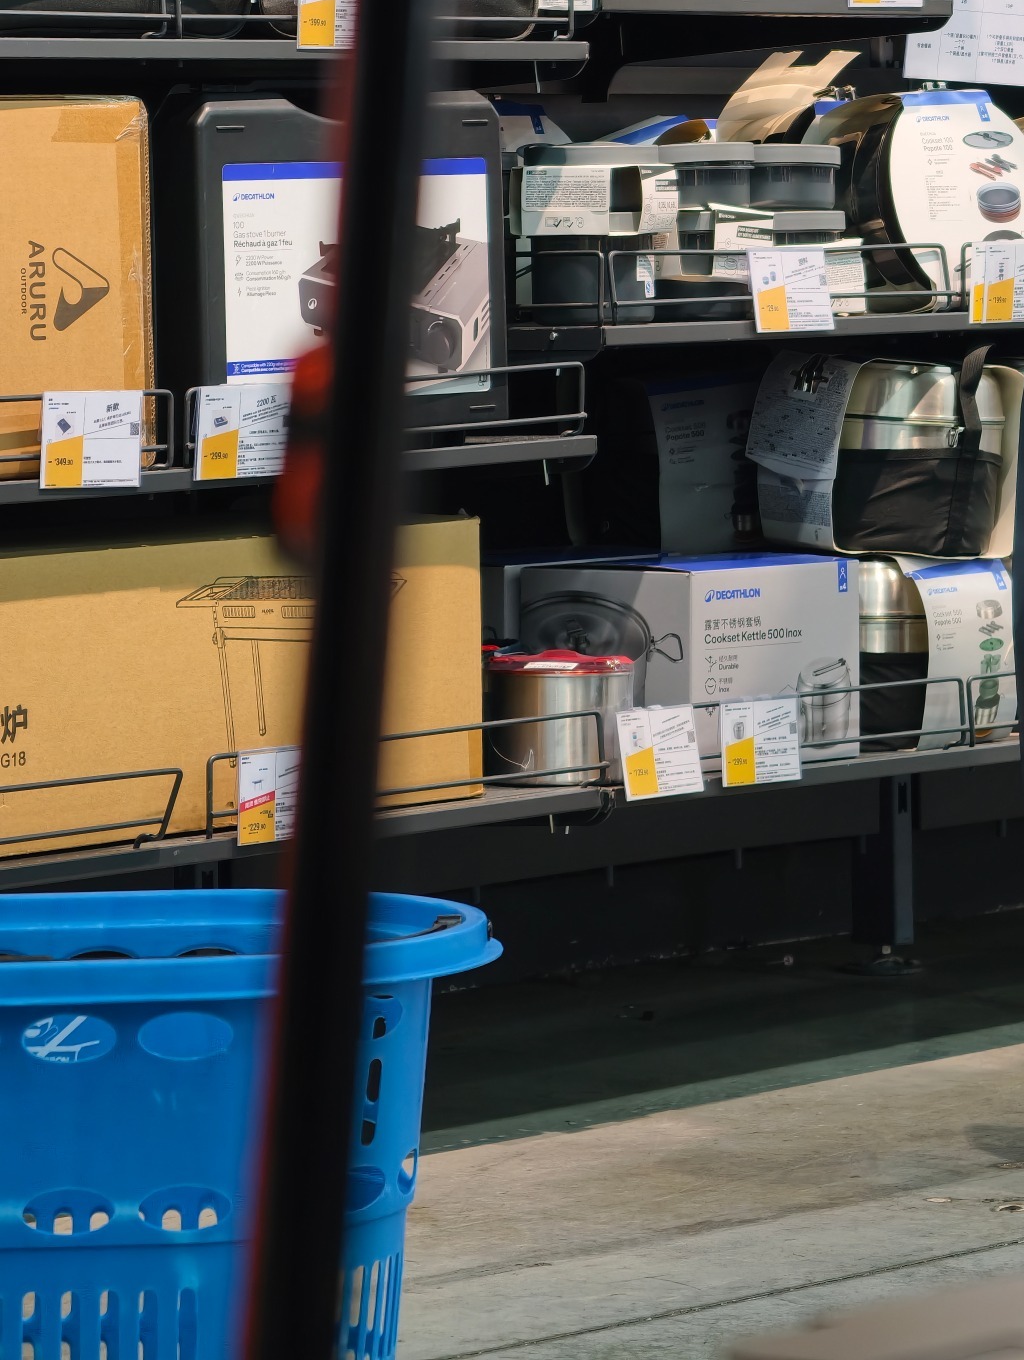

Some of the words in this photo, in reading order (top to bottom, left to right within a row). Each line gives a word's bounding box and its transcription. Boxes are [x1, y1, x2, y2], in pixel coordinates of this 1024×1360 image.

[922, 137, 943, 145] Cookset
[240, 192, 275, 201] DECATHLON
[232, 221, 245, 230] 100
[232, 230, 246, 239] Gas
[246, 230, 263, 239] stove
[266, 229, 287, 238] burner
[233, 239, 261, 248] Réchaud
[266, 240, 278, 249] gaz
[20, 267, 28, 315] OUTDOOR
[28, 240, 47, 342] ARURU
[716, 588, 761, 601] DECATHLON
[704, 615, 762, 632] 露营不锈钢套锅
[704, 631, 741, 645] Cookset
[741, 629, 767, 641] Kettle
[767, 628, 785, 640] 500
[785, 627, 803, 639] Inox
[718, 662, 739, 671] Durable
[0, 705, 28, 745] 炉
[0, 751, 27, 769] G18
